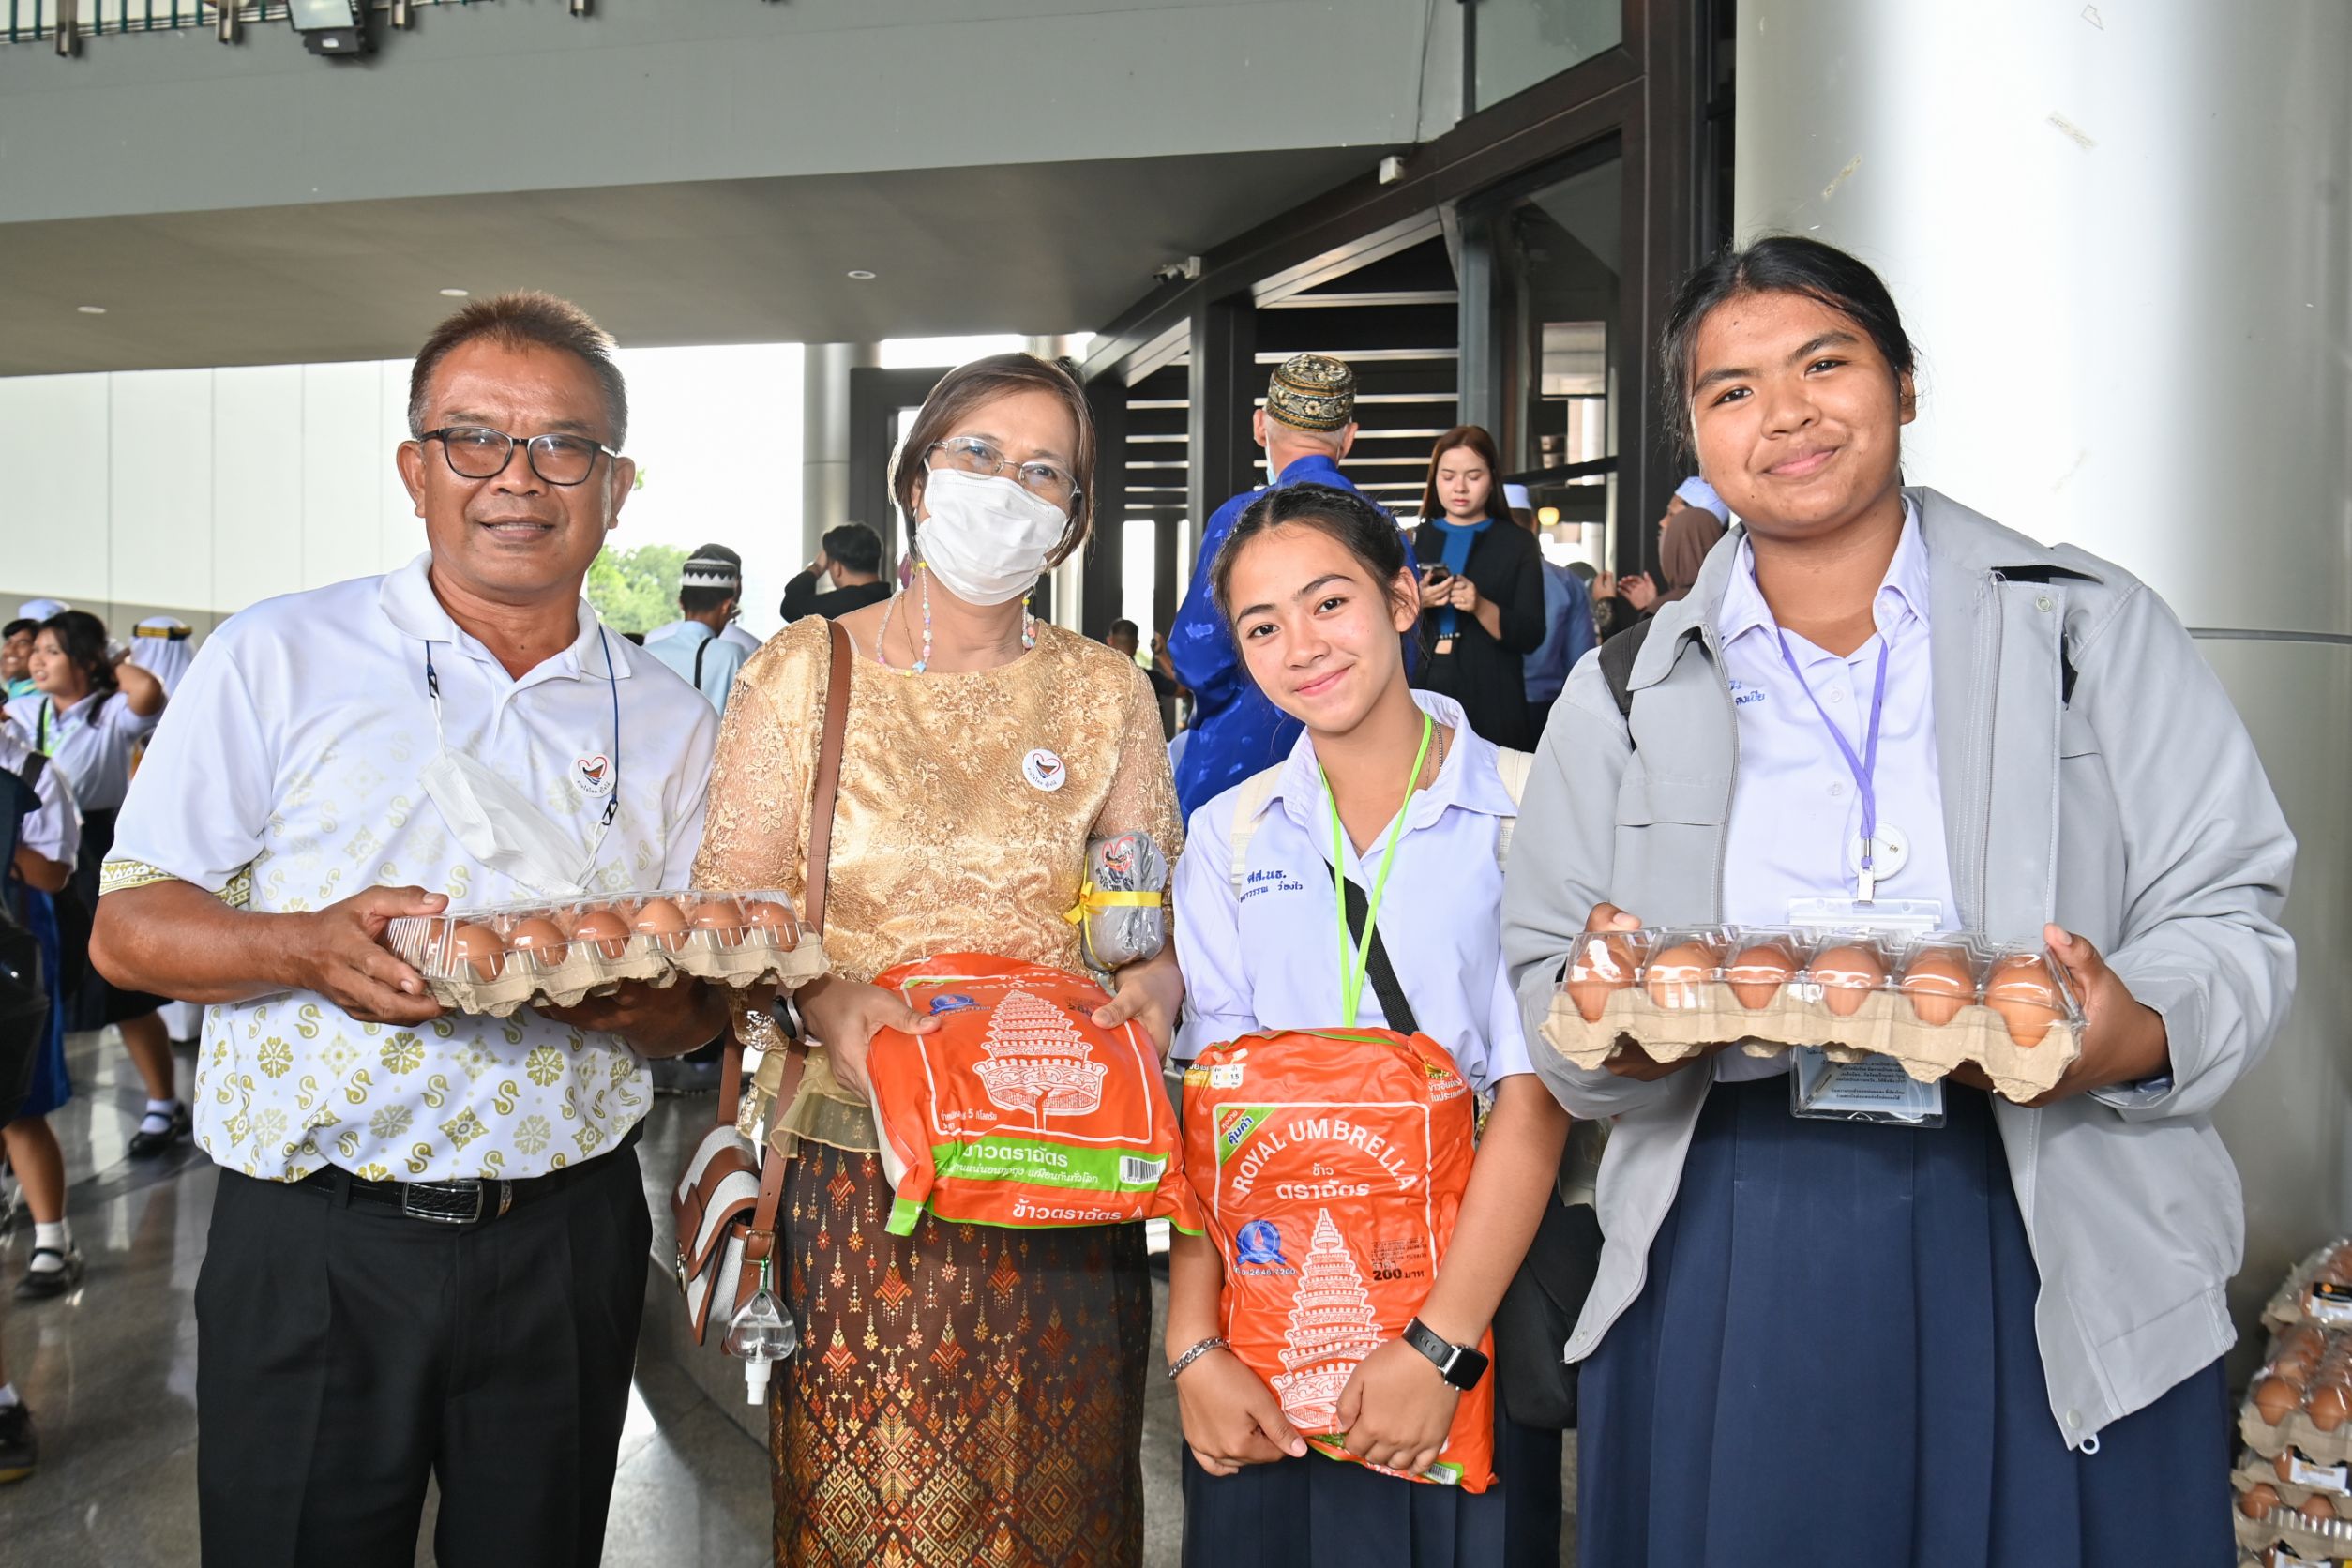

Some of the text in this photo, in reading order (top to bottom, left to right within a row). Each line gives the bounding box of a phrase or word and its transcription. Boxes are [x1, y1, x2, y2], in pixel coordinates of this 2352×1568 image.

[968, 1108, 974, 1119] 5
[1231, 1118, 1418, 1195] ROYAL UMBRELLA
[1312, 1162, 1334, 1177] ข้าว
[1275, 1179, 1371, 1199] ตราฉัตร
[1012, 1198, 1122, 1221] ข้าวตราฉัตร
[1372, 1268, 1425, 1281] 200 บาท
